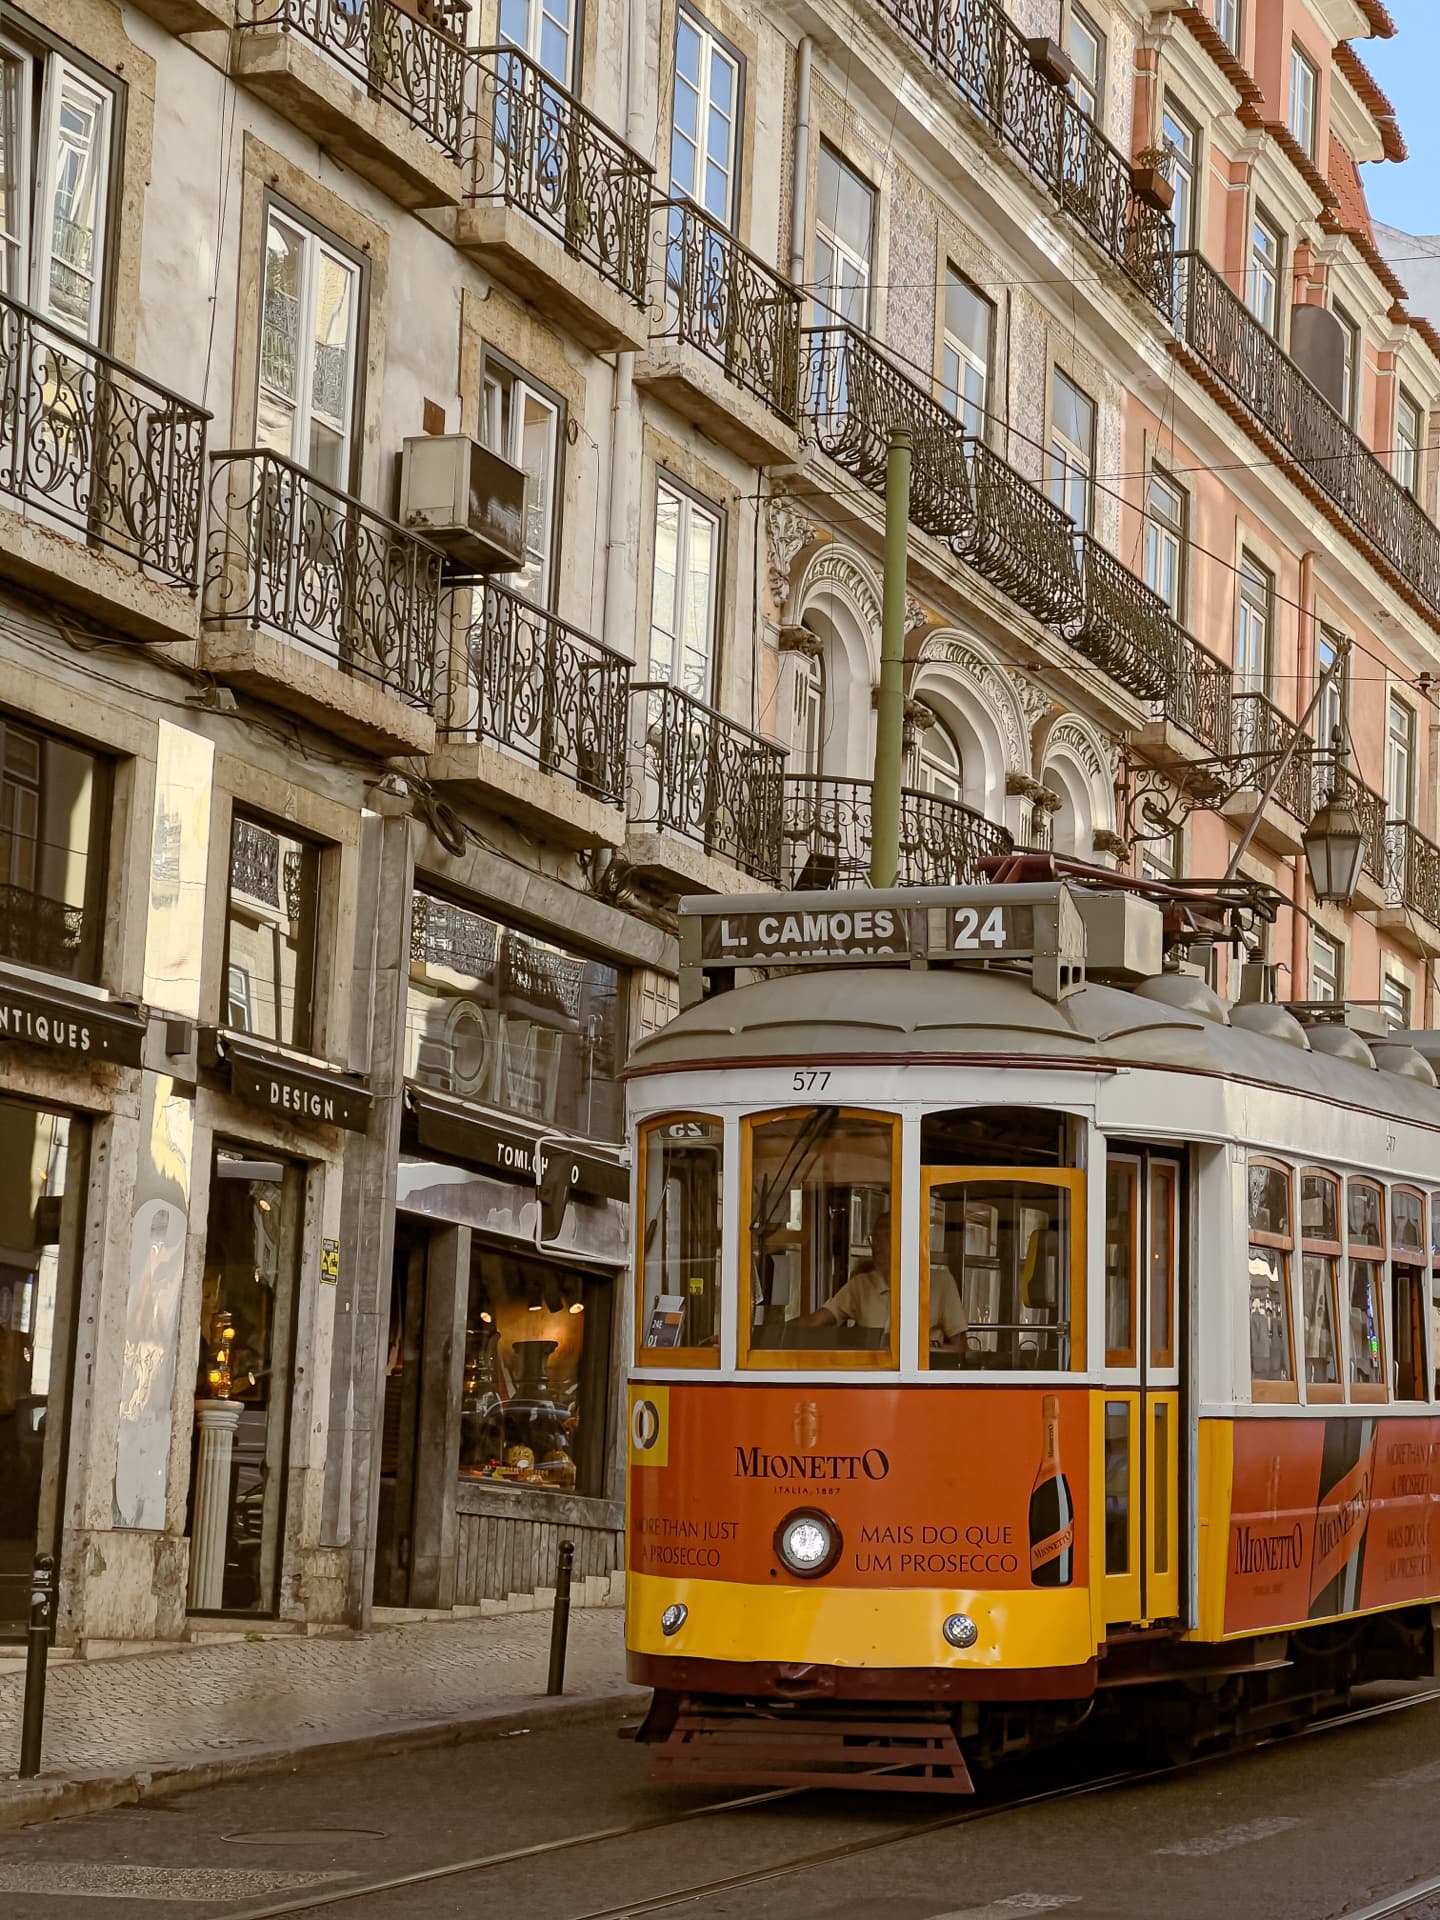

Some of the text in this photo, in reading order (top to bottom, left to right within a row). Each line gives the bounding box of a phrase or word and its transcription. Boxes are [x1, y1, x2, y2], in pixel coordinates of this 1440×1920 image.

[721, 910, 894, 947] L. CAMOES
[954, 906, 1006, 949] 24
[0, 1006, 90, 1050] NTIQUES
[793, 1071, 831, 1091] 577
[270, 1082, 334, 1120] DESIGN
[734, 1446, 889, 1480] MIONETTO
[661, 1518, 699, 1537] THAN
[702, 1521, 740, 1540] JUST
[860, 1525, 1014, 1549] MAIS DO QUE
[650, 1545, 720, 1567] PROSECCO
[855, 1553, 1019, 1573] UM PROSECCO
[1234, 1522, 1303, 1575] MIONETTO
